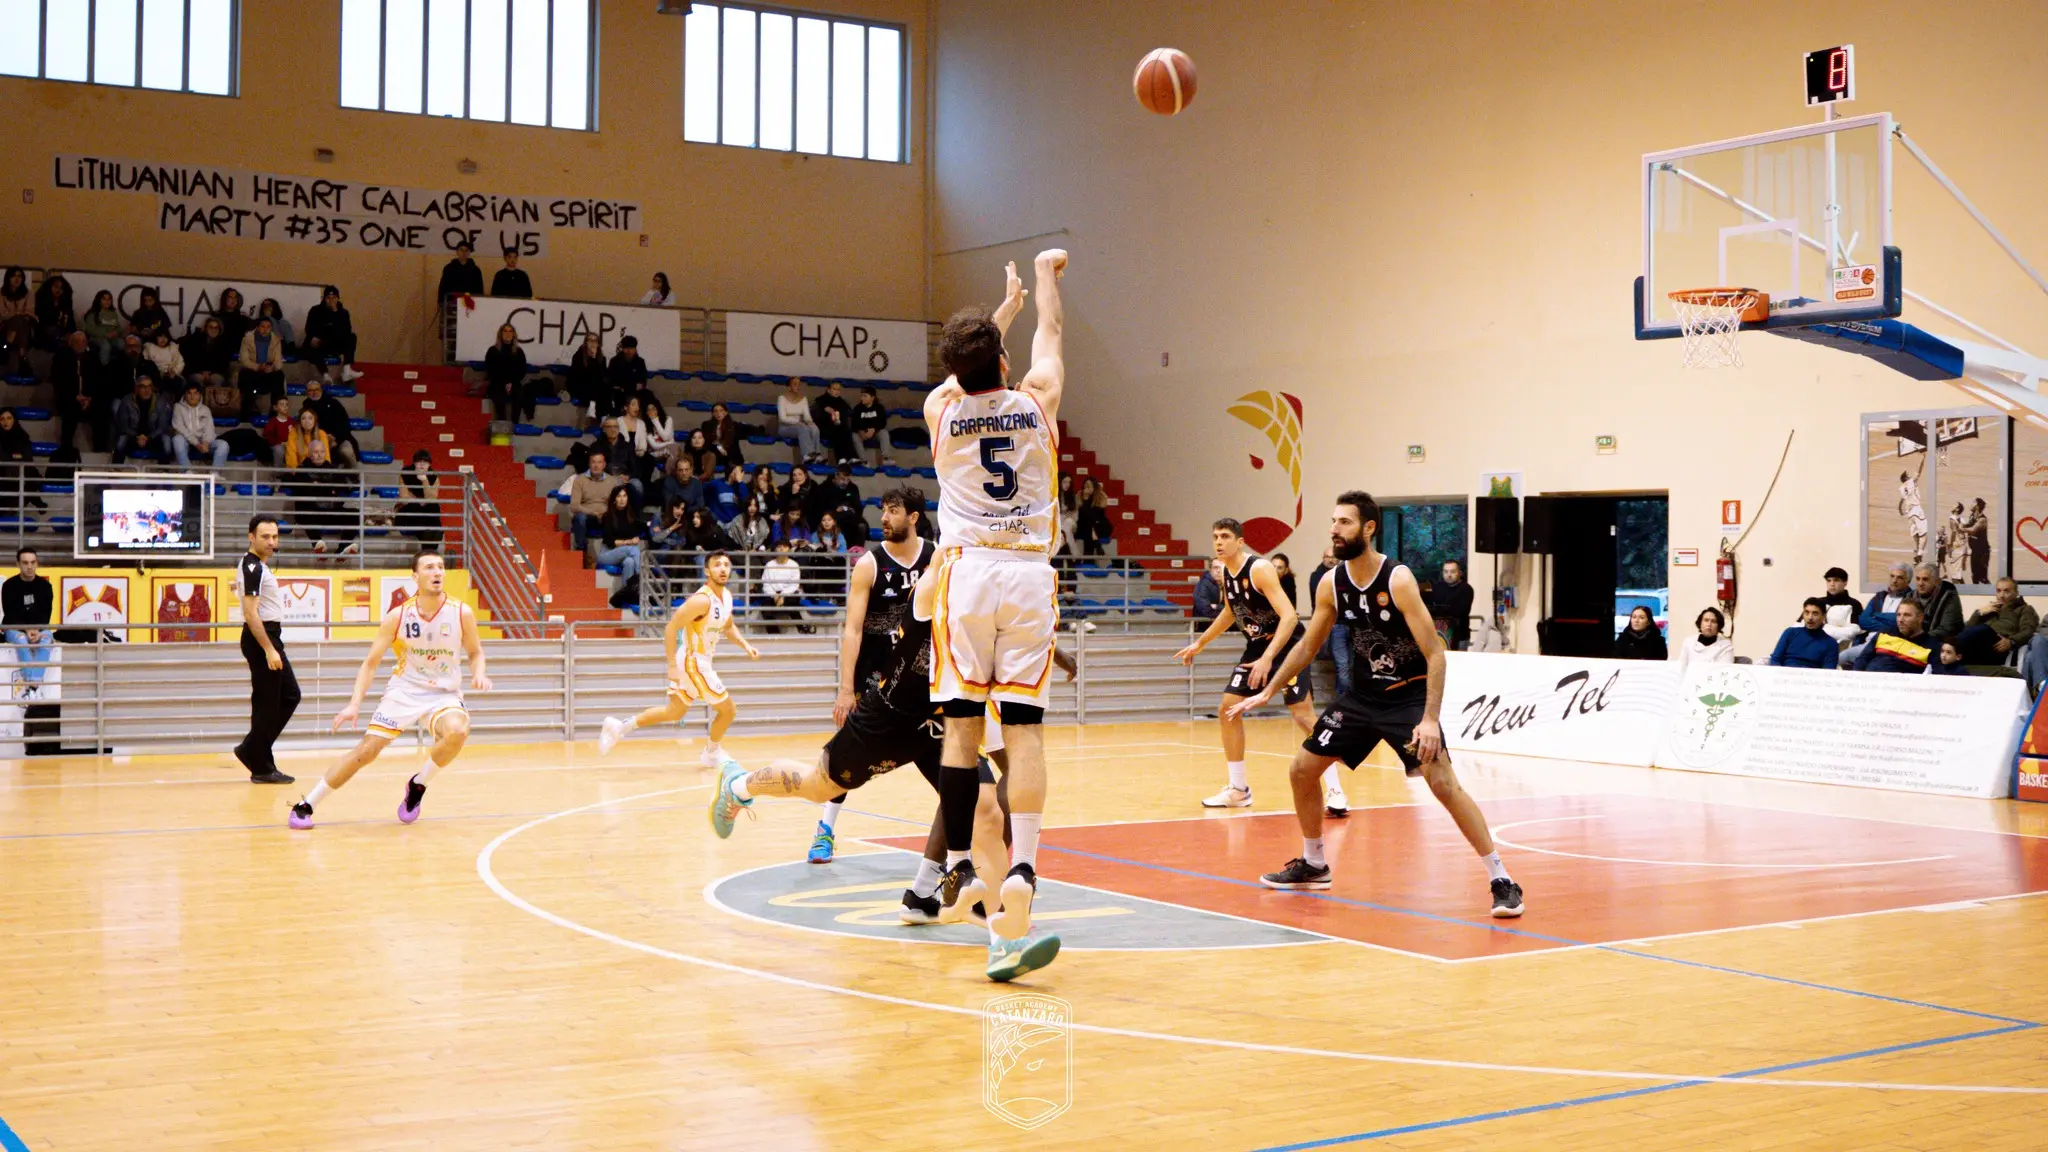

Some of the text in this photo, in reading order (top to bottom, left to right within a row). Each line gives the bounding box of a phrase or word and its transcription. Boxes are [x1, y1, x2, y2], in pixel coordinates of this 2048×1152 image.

[1829, 51, 1847, 89] 8
[253, 175, 348, 212] HEART
[161, 202, 540, 256] MARTY #35 ONE OF US
[950, 412, 1037, 437] CARPANZANO
[979, 436, 1018, 501] 5
[901, 571, 919, 589] 18
[1359, 594, 1370, 613] 4
[406, 622, 421, 638] 19
[1231, 674, 1242, 687] 8
[1461, 669, 1621, 741] New Tel
[1318, 729, 1333, 746] 4
